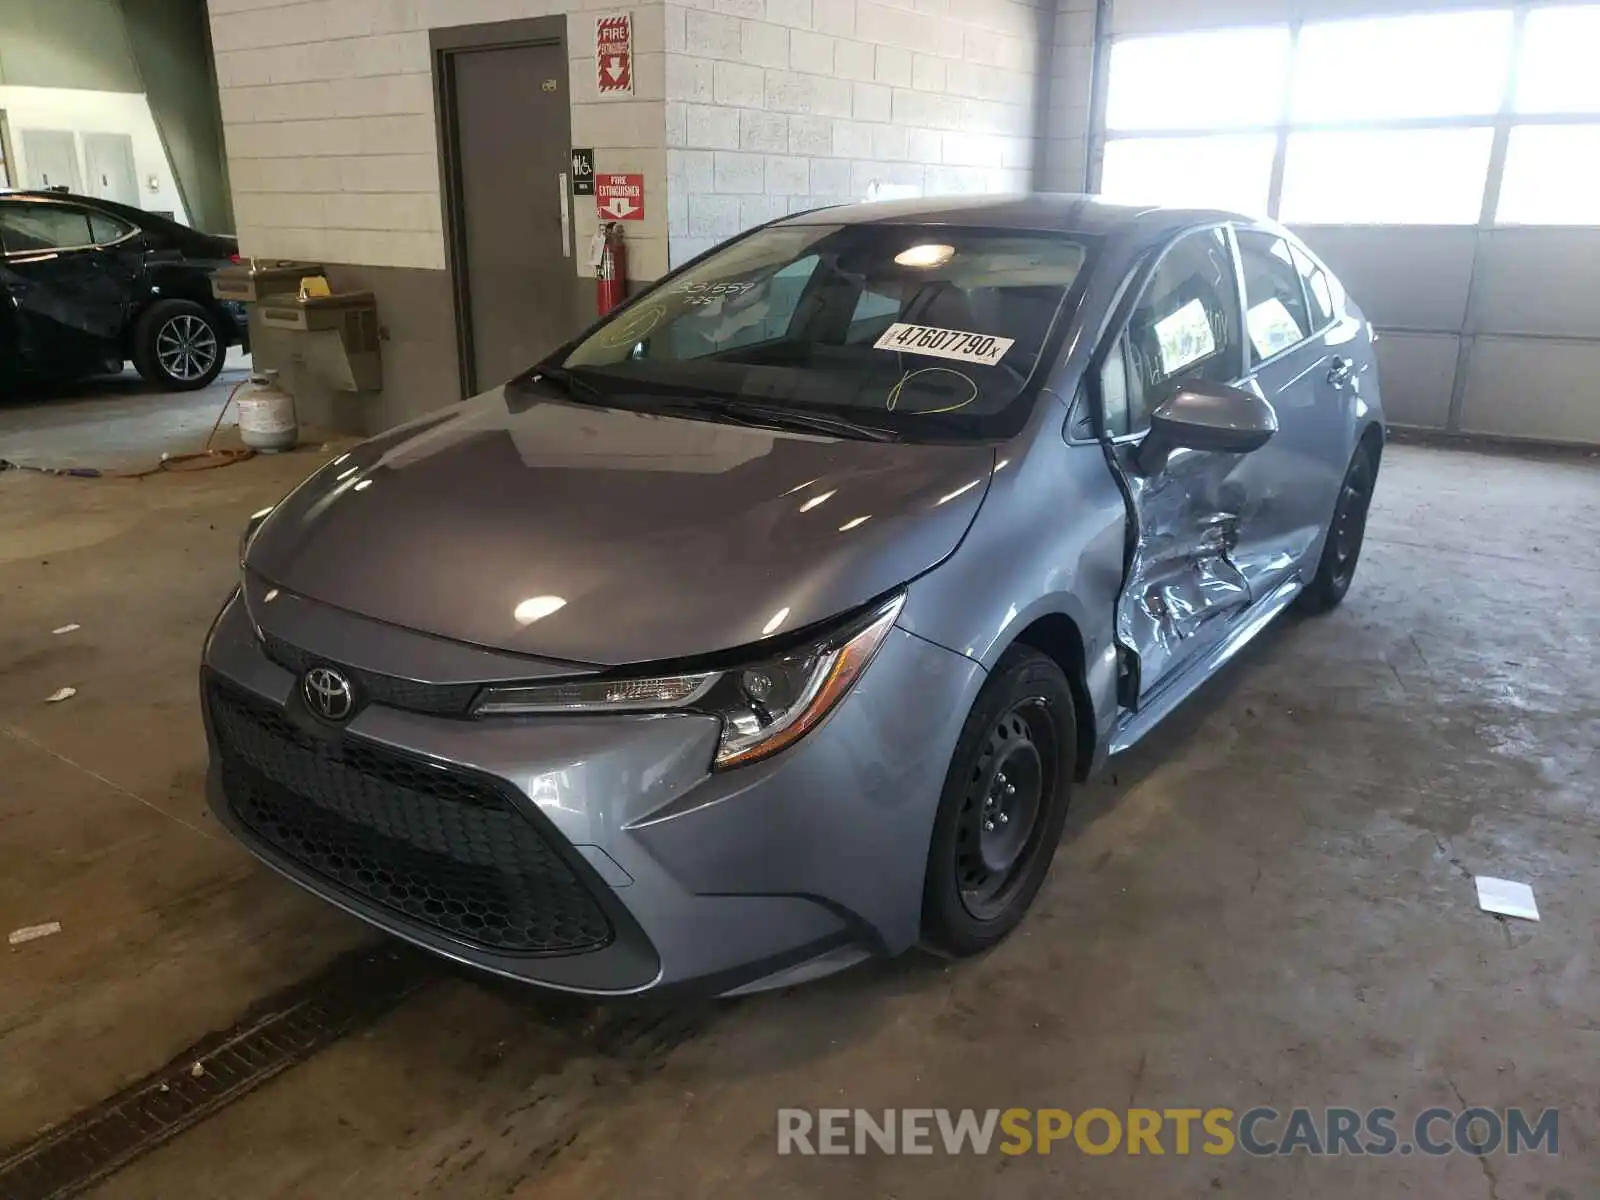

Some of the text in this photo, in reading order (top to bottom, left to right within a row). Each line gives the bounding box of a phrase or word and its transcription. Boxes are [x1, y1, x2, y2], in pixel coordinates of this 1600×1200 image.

[603, 27, 625, 40] FIRE
[610, 176, 627, 184] FIRE
[599, 185, 640, 196] EXTINGUISHER
